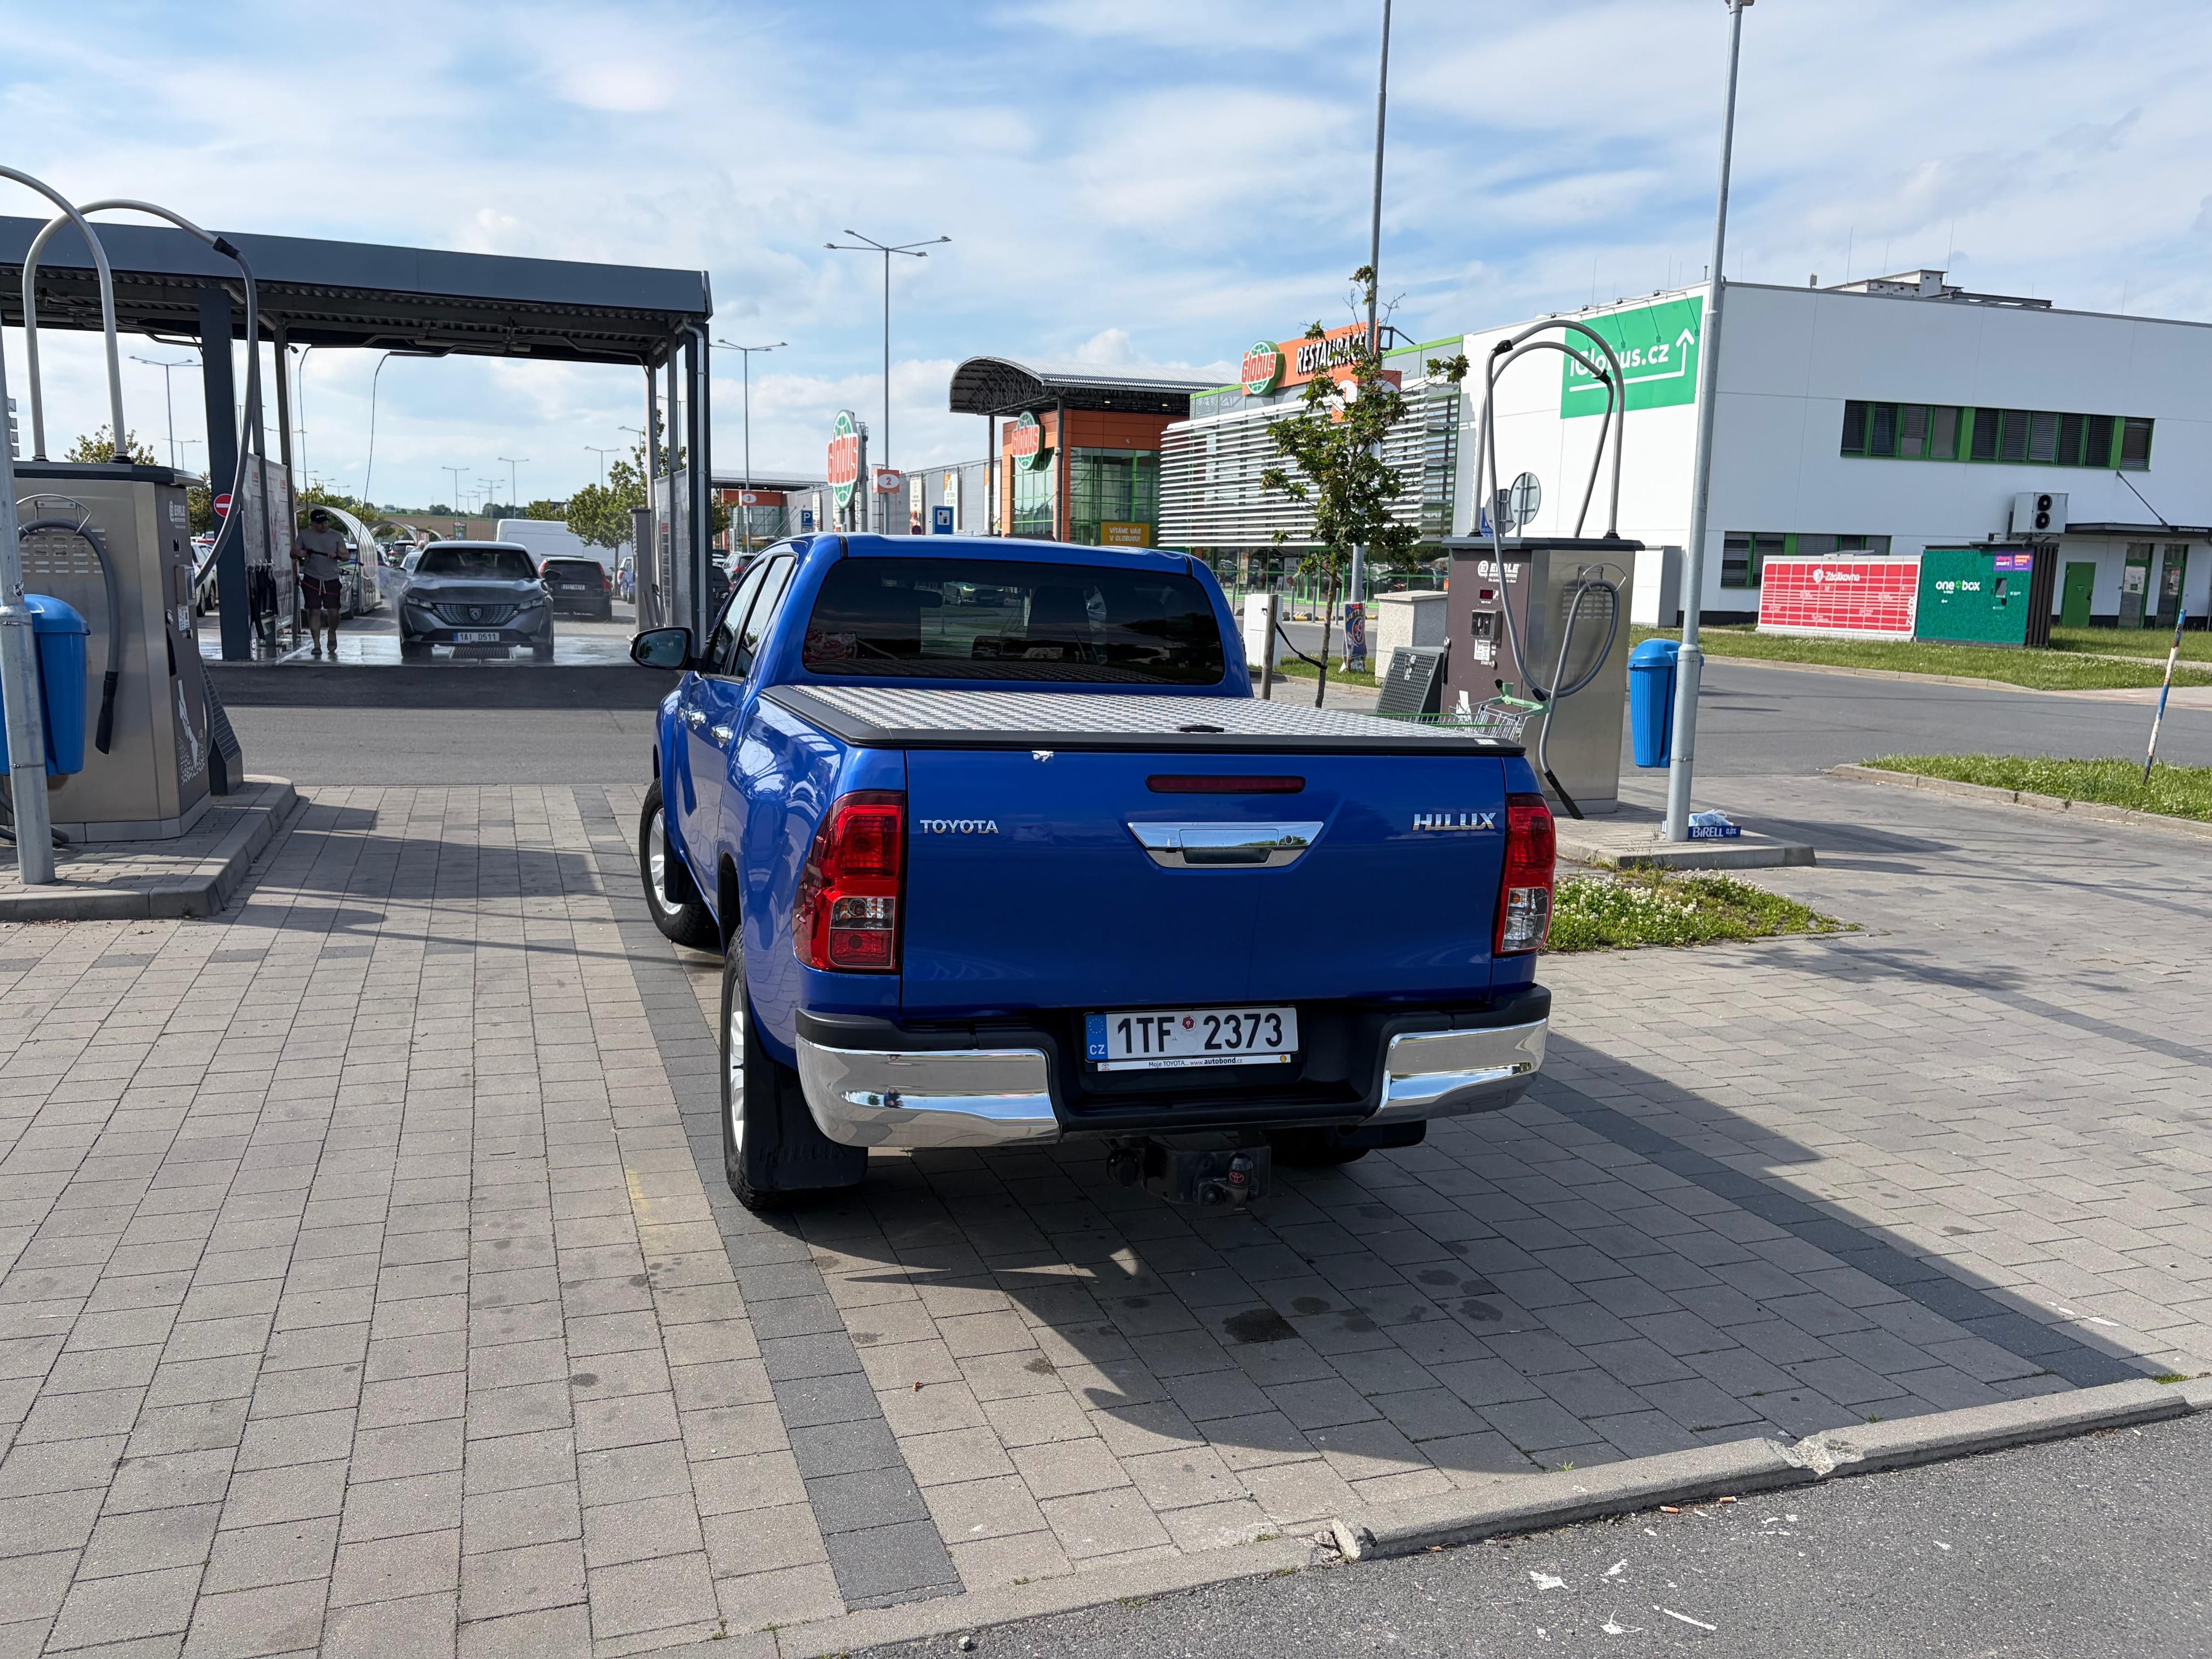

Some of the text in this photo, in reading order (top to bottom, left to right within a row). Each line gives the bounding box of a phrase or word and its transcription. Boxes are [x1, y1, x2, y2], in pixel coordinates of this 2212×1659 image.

[886, 476, 892, 485] 2
[803, 512, 811, 522] P
[1825, 571, 1860, 582] Zásilkovna
[1936, 579, 1980, 591] one box
[920, 819, 999, 834] TOYOTA
[1412, 812, 1496, 831] HILUX
[1117, 1013, 1283, 1054] 1TF 2373
[1089, 1044, 1105, 1055] CZ
[1190, 1057, 1243, 1066] www.autobond.cz
